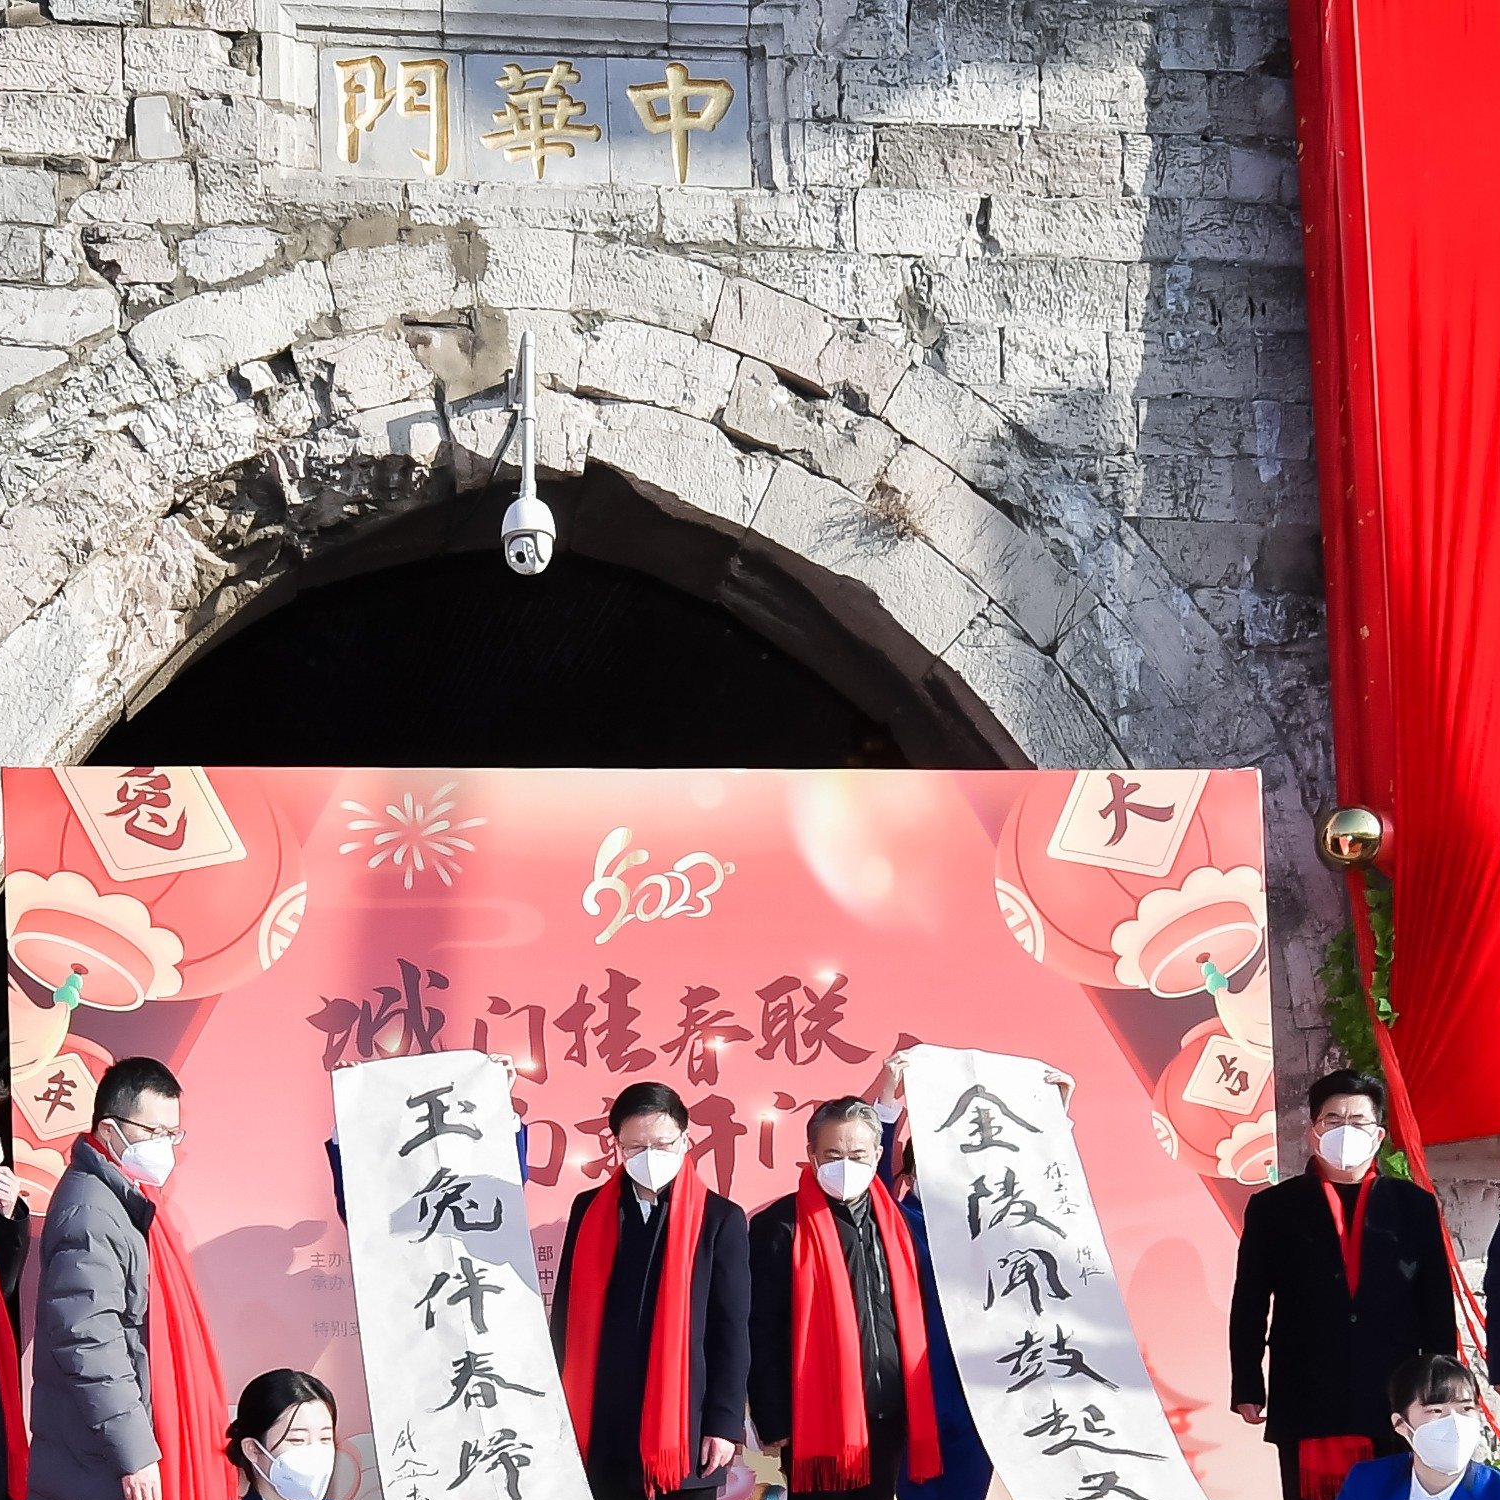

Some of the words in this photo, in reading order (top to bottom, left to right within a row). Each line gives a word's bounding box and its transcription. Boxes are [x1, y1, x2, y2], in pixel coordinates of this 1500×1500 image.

[1098, 773, 1176, 847] 大
[582, 826, 736, 945] 2023
[306, 959, 876, 1085] 城门挂春联
[34, 1070, 78, 1124] 年
